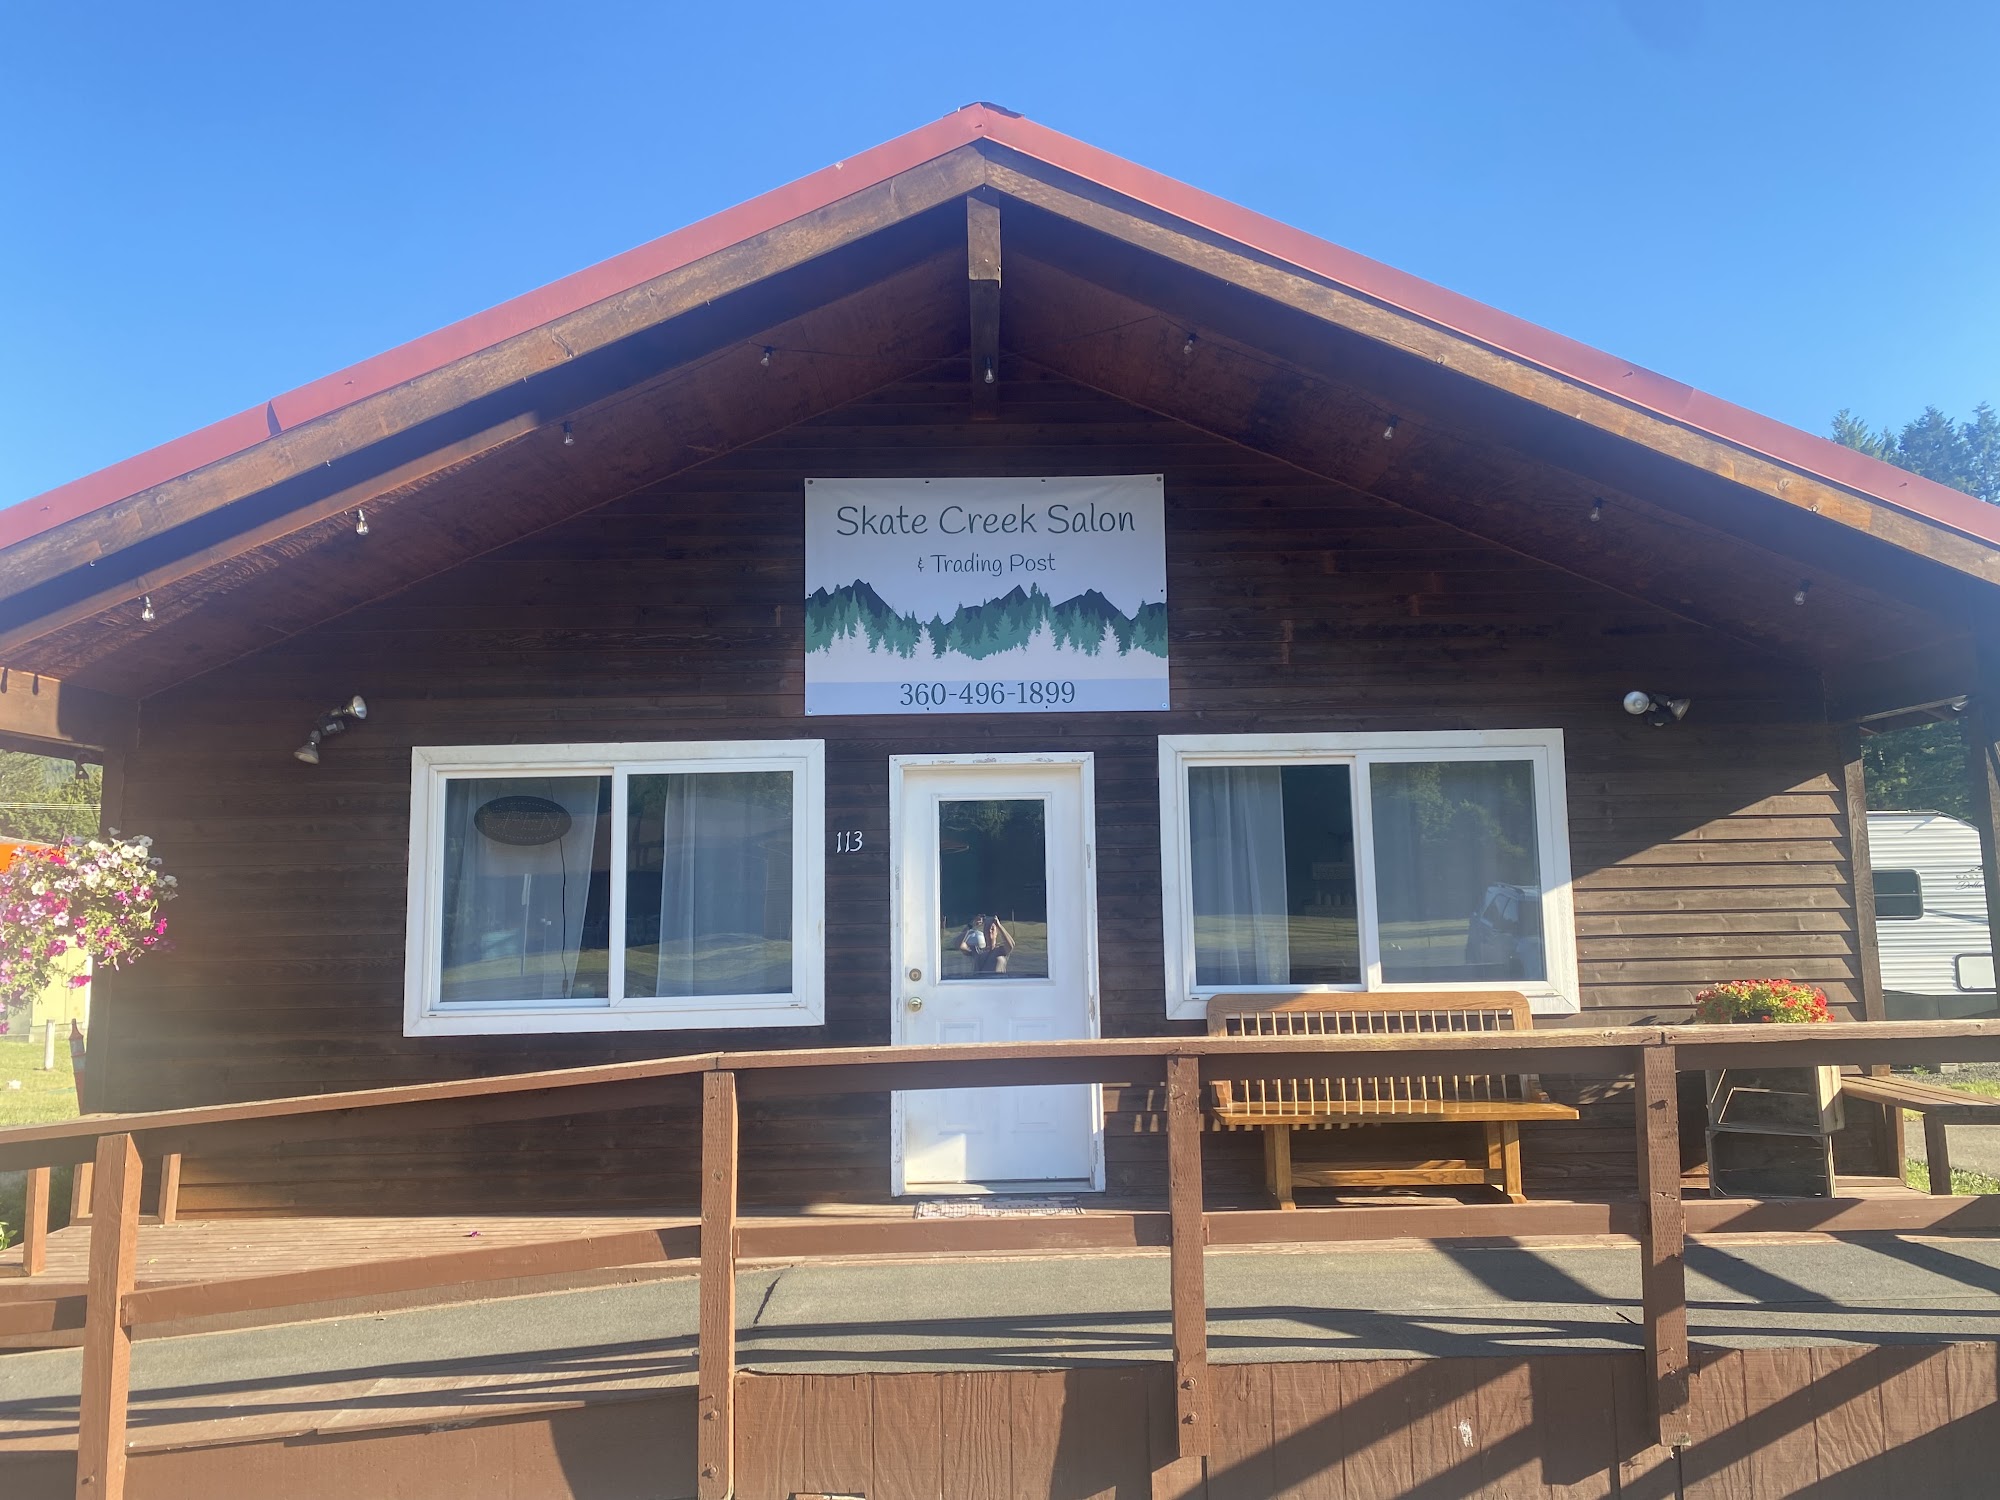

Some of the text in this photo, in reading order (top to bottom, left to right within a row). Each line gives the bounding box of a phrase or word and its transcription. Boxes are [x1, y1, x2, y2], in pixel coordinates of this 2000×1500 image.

[836, 502, 1136, 536] Skate Creek Salon
[929, 552, 1003, 577] Trading
[1009, 552, 1057, 573] Post
[899, 680, 1077, 706] 360-496-1899
[484, 809, 562, 831] OPEN
[836, 830, 864, 854] 113
